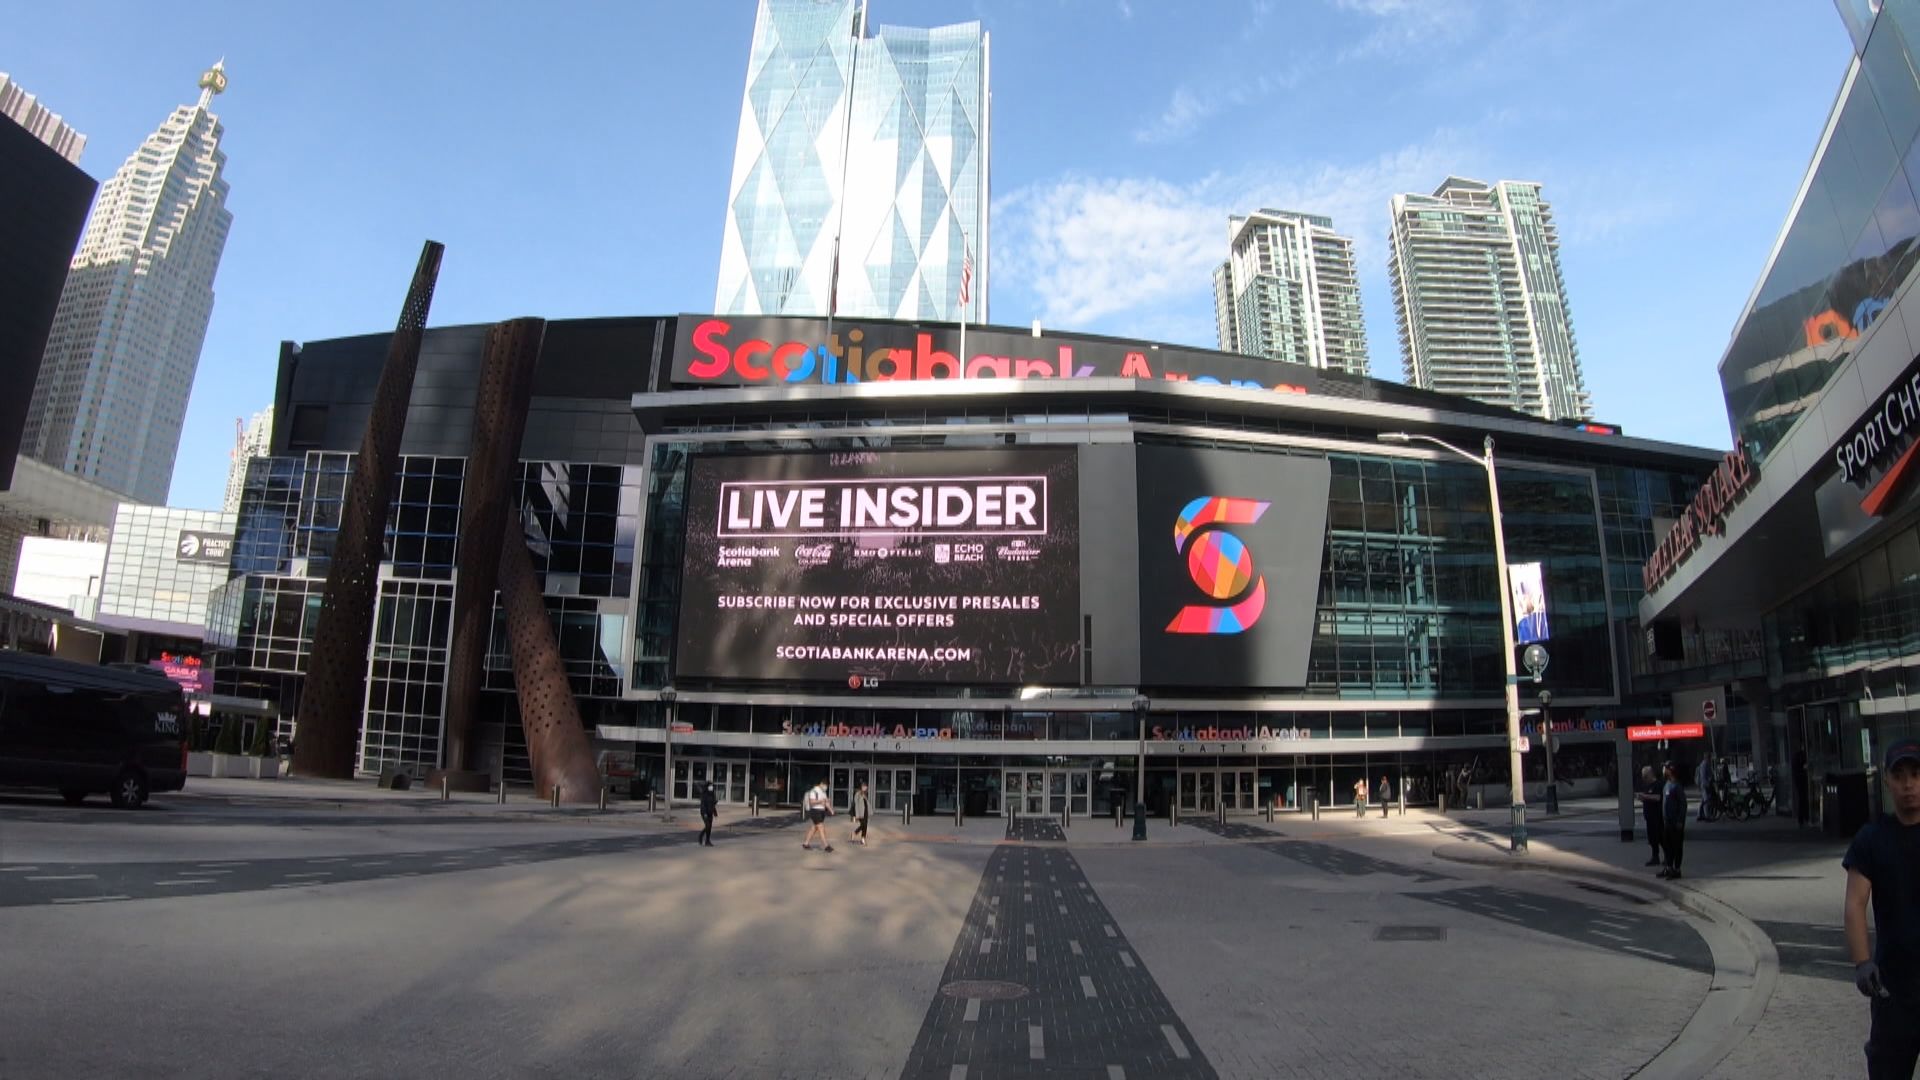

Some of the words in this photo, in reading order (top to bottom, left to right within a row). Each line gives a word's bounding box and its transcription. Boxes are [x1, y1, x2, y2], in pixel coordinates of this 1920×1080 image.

[727, 488, 826, 529] LIVE
[840, 485, 1038, 528] INSIDER
[1642, 537, 1671, 592] MAPLE
[1669, 505, 1694, 565] LEAF
[1694, 437, 1751, 535] SQUARE
[718, 545, 780, 558] Scotiabank
[854, 549, 877, 557] BMO
[889, 548, 921, 557] FIELD
[954, 544, 984, 553] ECHO
[717, 557, 752, 568] Arena
[954, 553, 984, 562] BEACH
[718, 595, 796, 609] SUBSCRIBE
[799, 595, 837, 609] NOW
[840, 595, 871, 610] FOR
[875, 595, 958, 610] EXCLUSIVE
[962, 595, 1040, 610] PRESALES
[793, 613, 826, 626] AND
[829, 613, 892, 627] SPECIAL
[895, 613, 955, 627] OFFERS
[776, 646, 971, 661] SCOTIABANKARENA.COM
[863, 676, 879, 688] LG
[154, 719, 180, 735] KING
[782, 720, 886, 738] Scotiabank
[892, 723, 952, 740] Arena
[1152, 724, 1255, 741] Scotiabank
[1259, 725, 1312, 741] Arena
[1178, 744, 1247, 753] GATE
